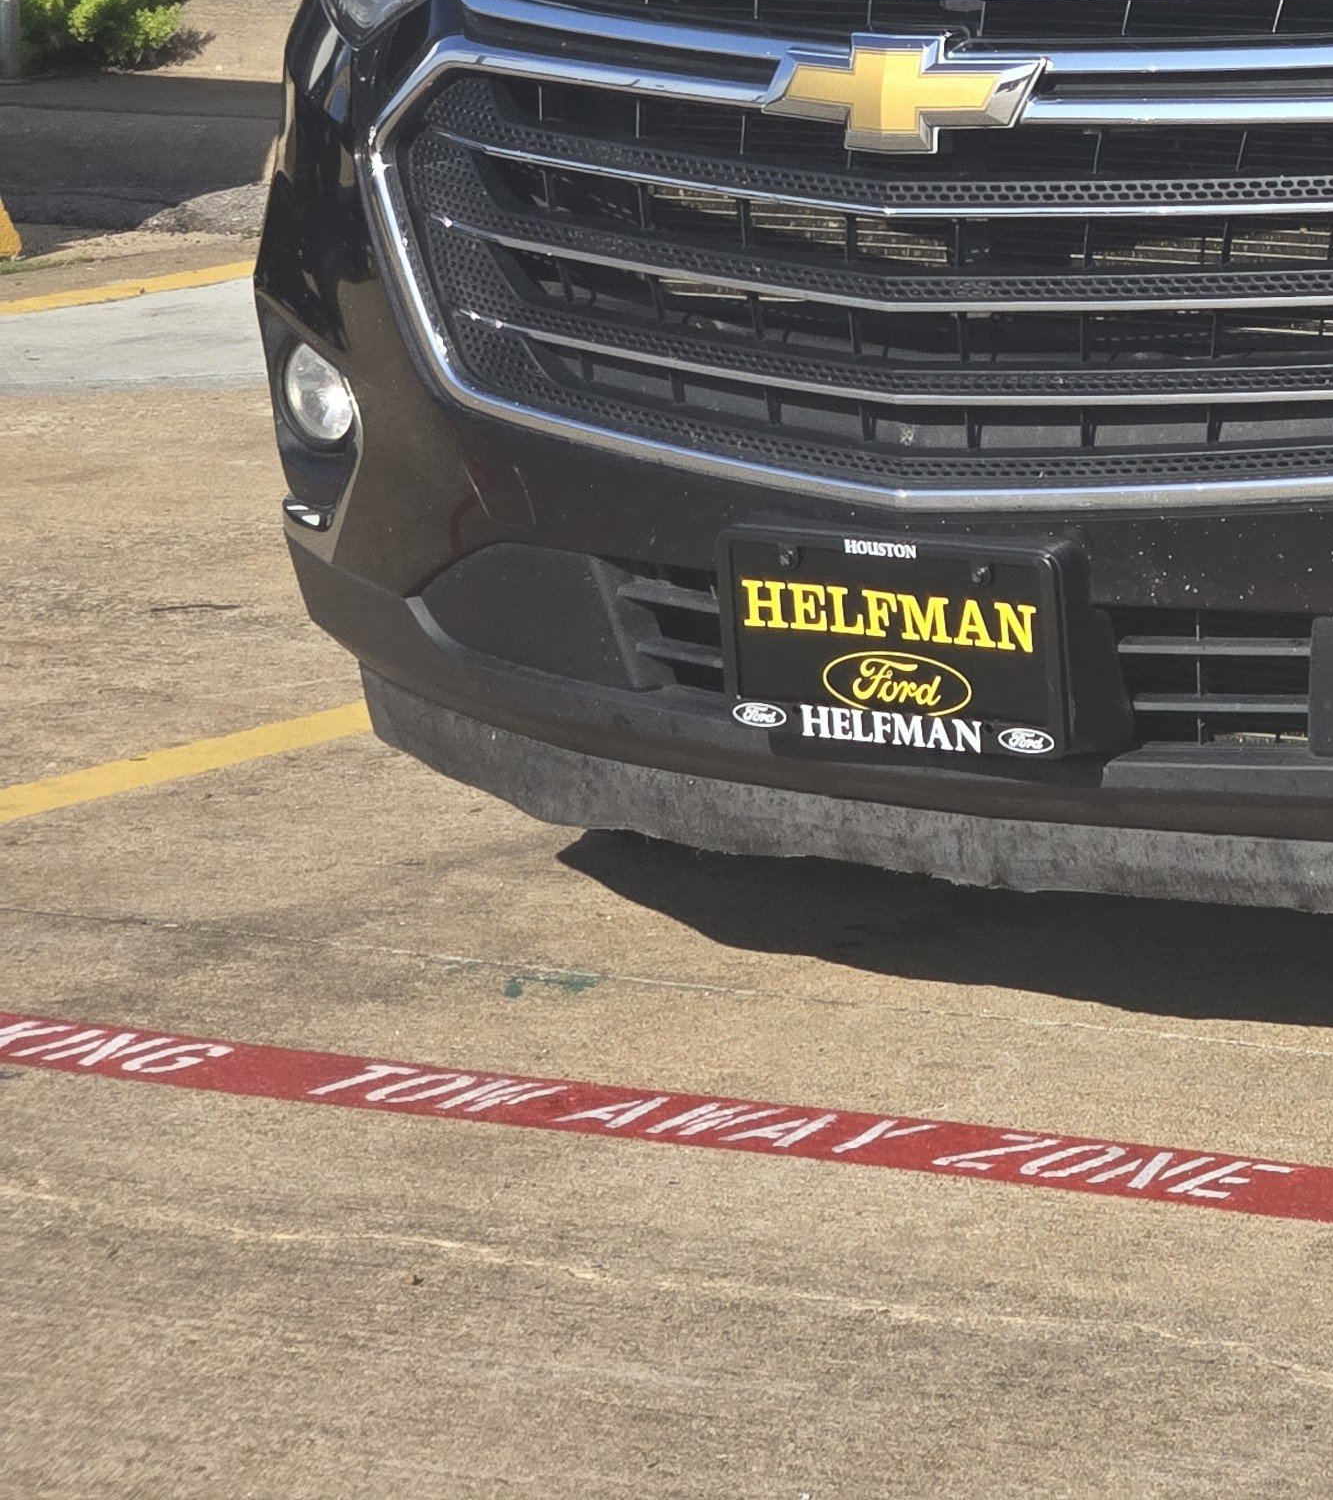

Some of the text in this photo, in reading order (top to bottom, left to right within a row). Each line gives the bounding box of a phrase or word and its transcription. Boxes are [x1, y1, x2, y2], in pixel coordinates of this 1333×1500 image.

[844, 538, 917, 559] HOUSTON
[741, 578, 1037, 653] HELFMAN
[852, 657, 942, 707] Ford
[742, 703, 1044, 754] Ford HELFMAN Ford
[308, 1064, 569, 1113] TOW
[549, 1096, 937, 1154] AWAY
[932, 1133, 1300, 1199] ZONE
